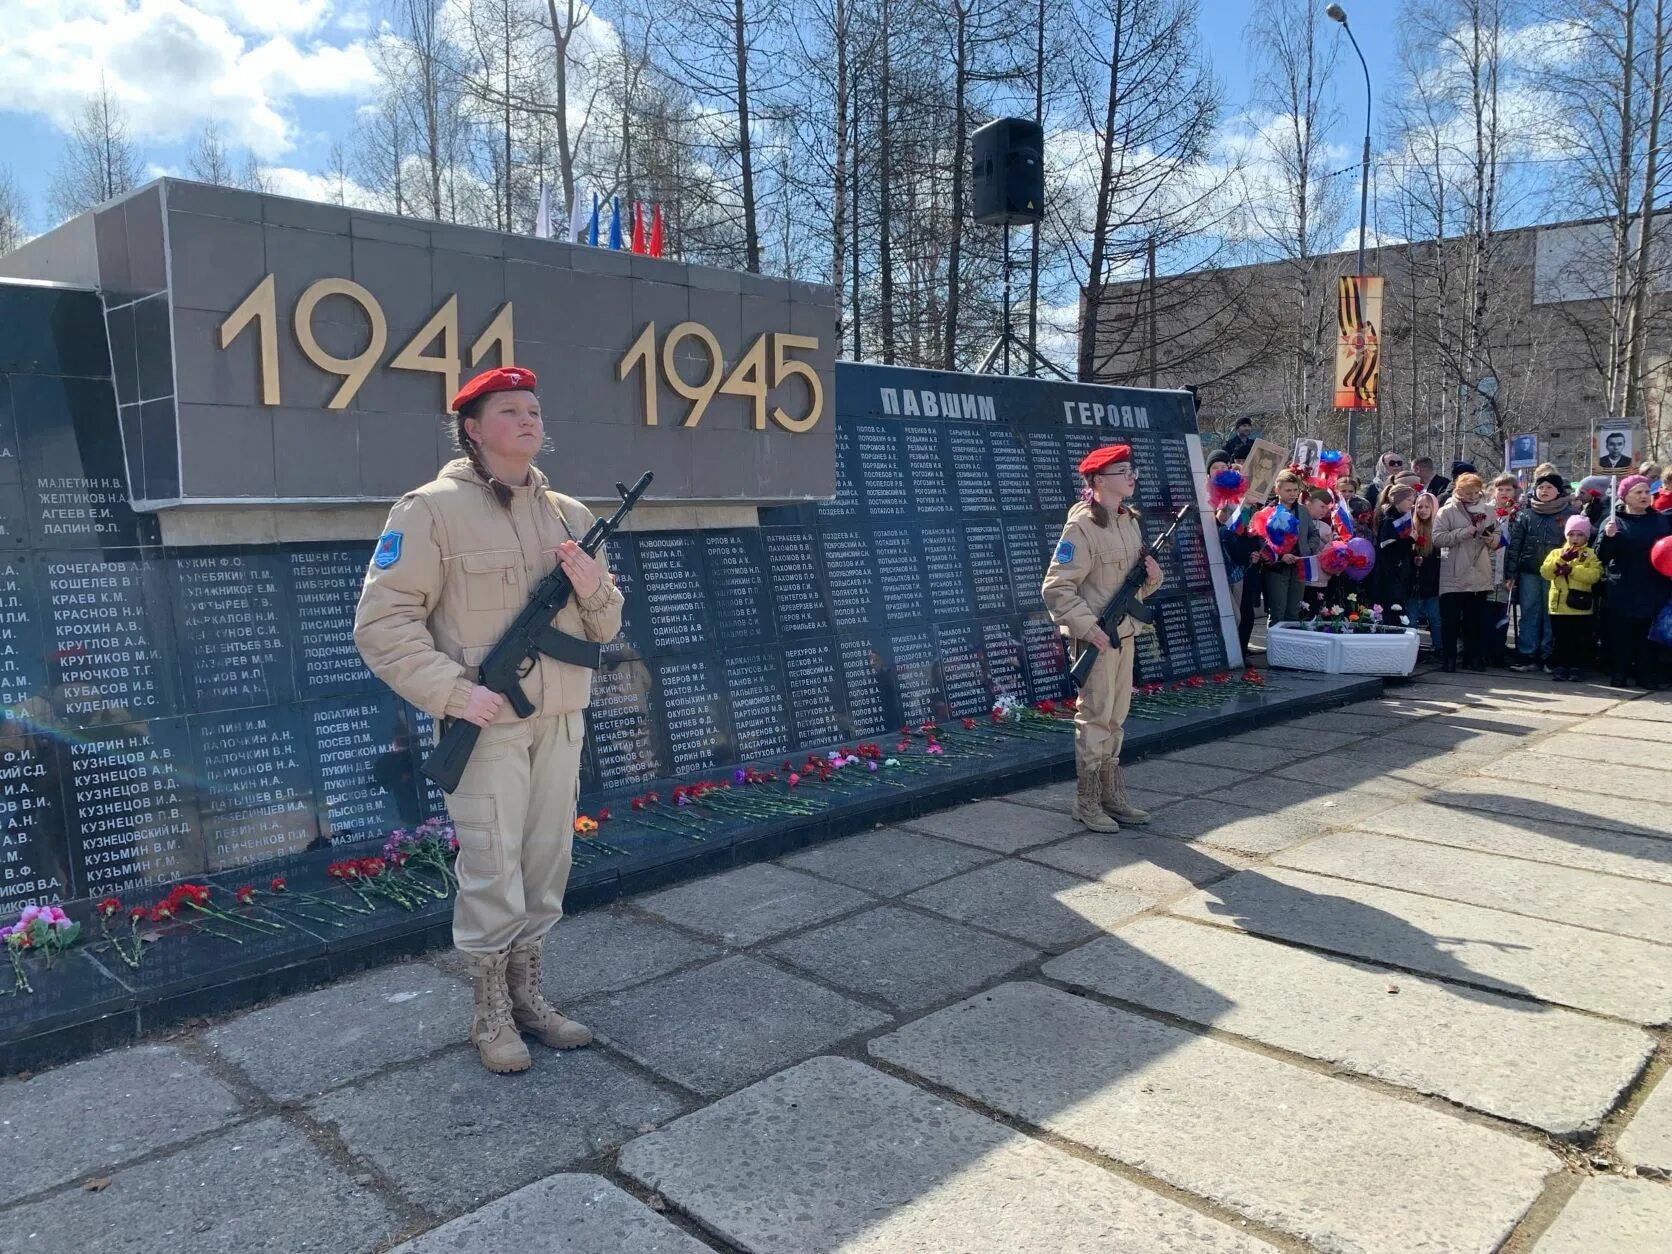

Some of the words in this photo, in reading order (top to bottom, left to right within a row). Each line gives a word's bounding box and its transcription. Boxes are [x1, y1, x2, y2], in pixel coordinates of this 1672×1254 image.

[217, 273, 515, 414] 1941
[617, 321, 824, 432] 1945
[880, 388, 997, 421] ПАВШИМ
[1063, 401, 1149, 429] ГЕРОЯМ
[38, 478, 98, 489] МАЛЕТИН
[40, 493, 106, 504] ЖЕЛТИКОВ
[42, 508, 85, 519] АГЕЕВ
[89, 508, 114, 518] Е.И.
[819, 508, 844, 516] ПОЗДЕЕВ
[44, 523, 90, 534] ЛАПИН
[94, 523, 121, 534] Ф.П.
[822, 532, 848, 540] ПОЗДЕЕВ
[291, 552, 330, 564] ЛЕШЕВ
[333, 550, 352, 561] Г.С.
[640, 549, 668, 559] НУДЬГА
[48, 561, 126, 575] КОЧЕГАРОВ
[642, 560, 668, 570] НУЩИК
[670, 559, 683, 568] Е.К.
[644, 570, 683, 581] ОБРАЗЦОВ
[773, 573, 802, 583] ПАХОМОВ
[50, 577, 118, 590] КОШЕЛЕВ
[646, 580, 687, 592] ОВЧАРЕНКО
[775, 583, 800, 593] ПАШКОВ
[52, 593, 96, 606] КРАЕВ
[101, 591, 128, 603] К.М.
[297, 592, 340, 604] ЛИНКИН
[648, 591, 692, 603] ОВЧИННИКОВ
[54, 607, 118, 621] КРАСНОВ
[123, 605, 149, 617] Н.И.
[649, 602, 694, 614] ОВЧИННИКОВ
[301, 618, 352, 632] ЛИСИЦИН
[651, 614, 680, 625] ОГИБИН
[682, 612, 694, 622] А.Г.
[56, 623, 110, 637] КРОХИН
[115, 620, 142, 632] А.В.
[653, 624, 689, 636] ОДИНЦОВ
[58, 637, 120, 652] КРУГЛОВ
[124, 635, 150, 647] А.А.
[655, 635, 690, 647] ОДИНЦОВ
[840, 639, 860, 649] ПОПОВ
[60, 651, 130, 668] КРУТИКОВ
[135, 649, 162, 661] М.И.
[785, 647, 817, 658] ПЕРХУРОВ
[307, 657, 362, 672] ЛОЗГАЧЕВ
[660, 663, 690, 676] ОЖИГИН
[787, 657, 812, 668] ПЕСКОВ
[62, 667, 129, 683] КРЮЧКОВ
[133, 664, 154, 677] Т.Г.
[309, 668, 371, 686] ЛОЗИНСКИЙ
[788, 664, 825, 678] ПЕСТОВСКИЙ
[1, 676, 32, 688] А.М.
[662, 674, 691, 686] ОЗЕРОВ
[790, 676, 822, 688] ПЕТРЕНКО
[64, 682, 128, 699] КУБАСОВ
[664, 685, 692, 697] ОКАТОВ
[694, 683, 708, 694] А.А.
[792, 687, 817, 698] ПЕТРОВ
[3, 692, 32, 704] В.Н.
[66, 697, 129, 714] КУДЕЛИН
[133, 694, 160, 707] С.С.
[665, 694, 705, 708] ОКОЛЫХИН
[5, 708, 34, 720] В.А.
[314, 707, 359, 723] ЛОПАТИН
[361, 705, 380, 717] В.Н.
[667, 707, 696, 719] ОКУЛОВ
[734, 705, 770, 719] ПАРТЮКОВ
[795, 707, 823, 718] ПЕТУХОВ
[316, 722, 350, 736] ЛОСЕВ
[352, 720, 370, 732] Н.Н.
[593, 717, 635, 731] НЕСТЕРОВ
[669, 718, 698, 730] ОКУНЕВ
[699, 715, 713, 726] Ф.Д.
[736, 717, 764, 730] ПАРШИН
[271, 731, 294, 744] А.Н.
[671, 728, 704, 741] ОНЧУРОВ
[706, 725, 720, 736] И.А.
[737, 726, 773, 740] ПАРФЕНОВ
[70, 739, 124, 756] КУДРИН
[129, 735, 154, 748] Н.К.
[318, 736, 352, 750] ЛОСЕВ
[672, 739, 702, 752] ОРЕХОВ
[703, 736, 718, 747] И.Ф.
[739, 736, 777, 751] ПАСТАРНАК
[4, 750, 36, 762] Ф.И.
[273, 745, 296, 758] В.Н.
[320, 745, 377, 764] ЛУГОВСКОЙ
[379, 743, 398, 756] М.Н.
[674, 751, 699, 763] ОРЛИН
[741, 747, 775, 761] ПАСТУХОВ
[72, 752, 145, 772] КУЗНЕЦОВ
[150, 748, 176, 761] А.В.
[276, 759, 300, 772] Н.А.
[599, 752, 637, 767] НИКОНОВ
[702, 759, 716, 770] А.А.
[24, 764, 47, 777] С.Д.
[74, 767, 147, 787] КУЗНЕЦОВ
[152, 763, 178, 777] А.Н.
[322, 764, 354, 778] ЛУКИН
[601, 762, 646, 778] НИКОНОРОВ
[324, 777, 356, 792] ЛУКИН
[357, 774, 377, 787] М.Н.
[602, 774, 641, 790] НОВИКОВ
[5, 785, 34, 796] И.А.
[76, 782, 149, 803] КУЗНЕЦОВ
[154, 778, 180, 792] В.Д.
[326, 789, 368, 806] ЛЫСКОВ
[370, 786, 388, 799] С.А.
[78, 798, 151, 819] КУЗНЕЦОВ
[156, 793, 182, 807] И.А.
[328, 804, 364, 819] ЛЫСОВ
[366, 800, 386, 813] В.М.
[8, 816, 38, 829] А.Н.
[80, 813, 153, 835] КУЗНЕЦОВ
[330, 818, 365, 833] ЛЯМОВ
[3, 833, 32, 847] А.В.
[82, 825, 169, 851] КУЗНЕЦОВСКИЙ
[171, 823, 192, 836] И.Д.
[332, 832, 365, 847] МАЗИН
[84, 845, 149, 866] КУЗЬМИН
[154, 840, 181, 855] В.М.
[5, 866, 36, 880] В.Ф.
[86, 861, 151, 882] КУЗЬМИН
[38, 878, 62, 890] В.А.
[88, 876, 153, 898] КУЗЬМИН
